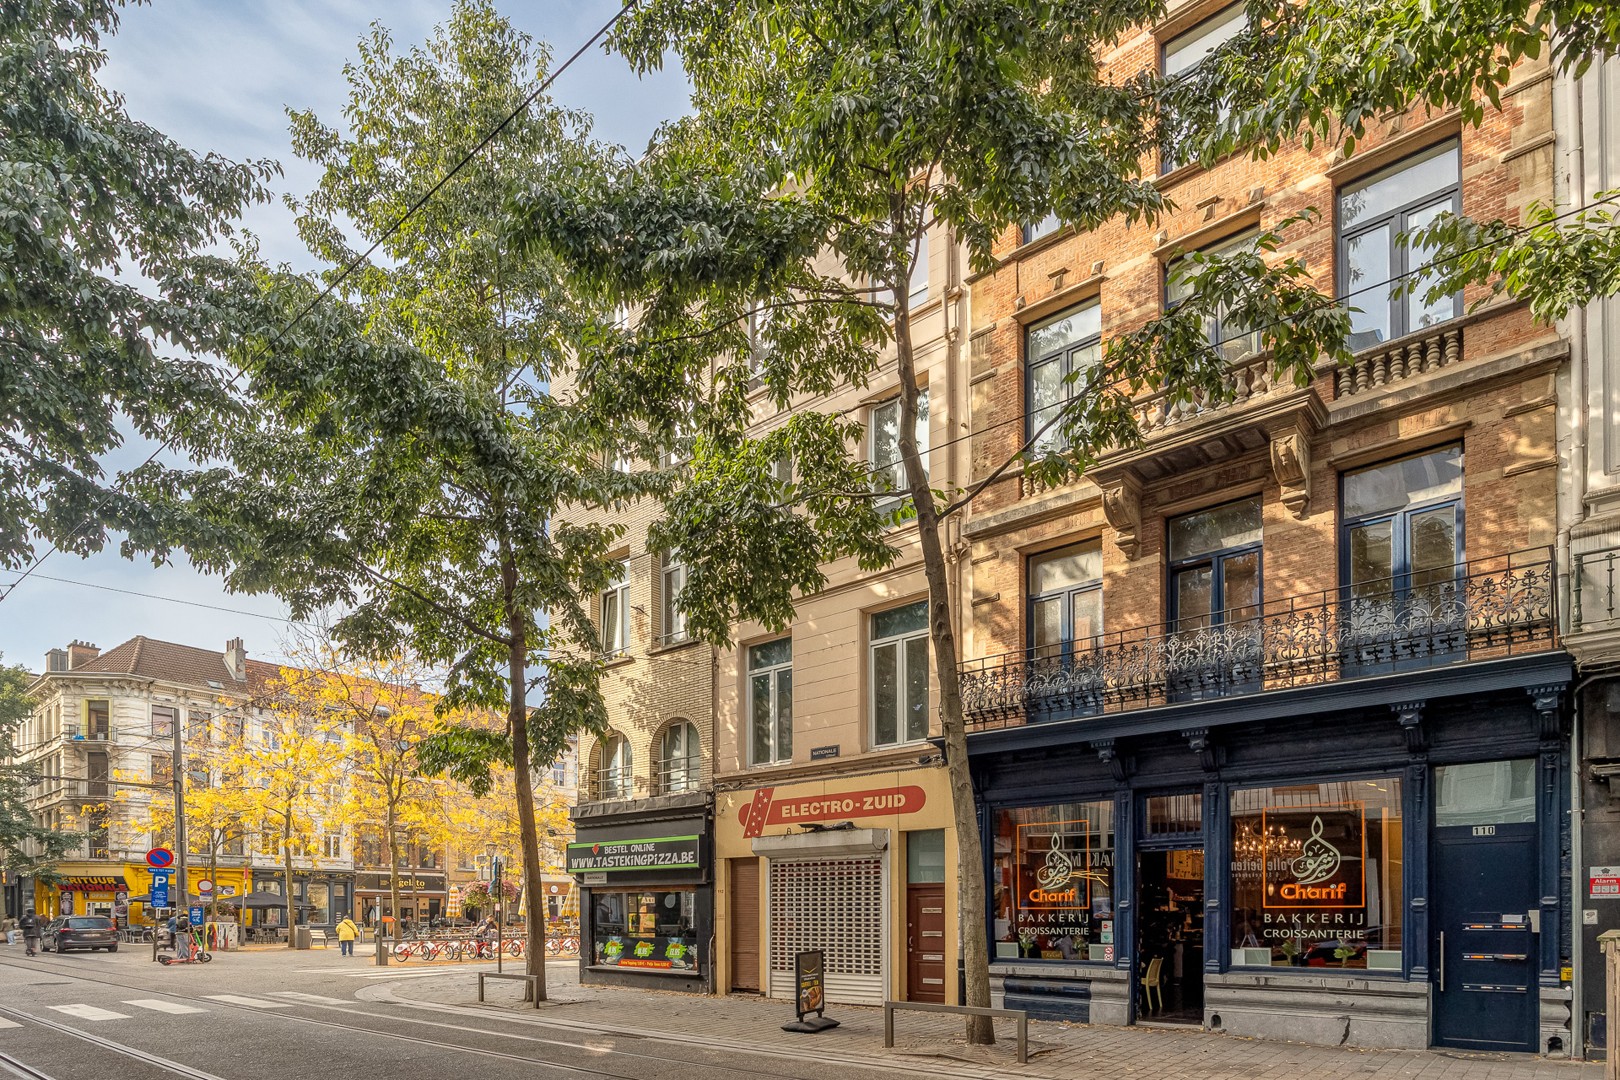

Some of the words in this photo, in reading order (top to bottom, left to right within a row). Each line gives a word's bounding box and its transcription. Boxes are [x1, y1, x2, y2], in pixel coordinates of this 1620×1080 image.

[781, 794, 906, 818] ELECTRO-ZUID
[1474, 826, 1494, 835] 110
[604, 845, 628, 855] BESTEL
[155, 876, 166, 887] P
[398, 878, 425, 888] gelto
[1029, 888, 1076, 902] Charif
[1280, 883, 1346, 900] Charif
[1018, 914, 1089, 923] BAKKERIJ
[1264, 913, 1364, 925] BAKKERIJ
[1018, 926, 1089, 935] CROISSANTERIE
[1263, 929, 1365, 939] CROISSANTERIE
